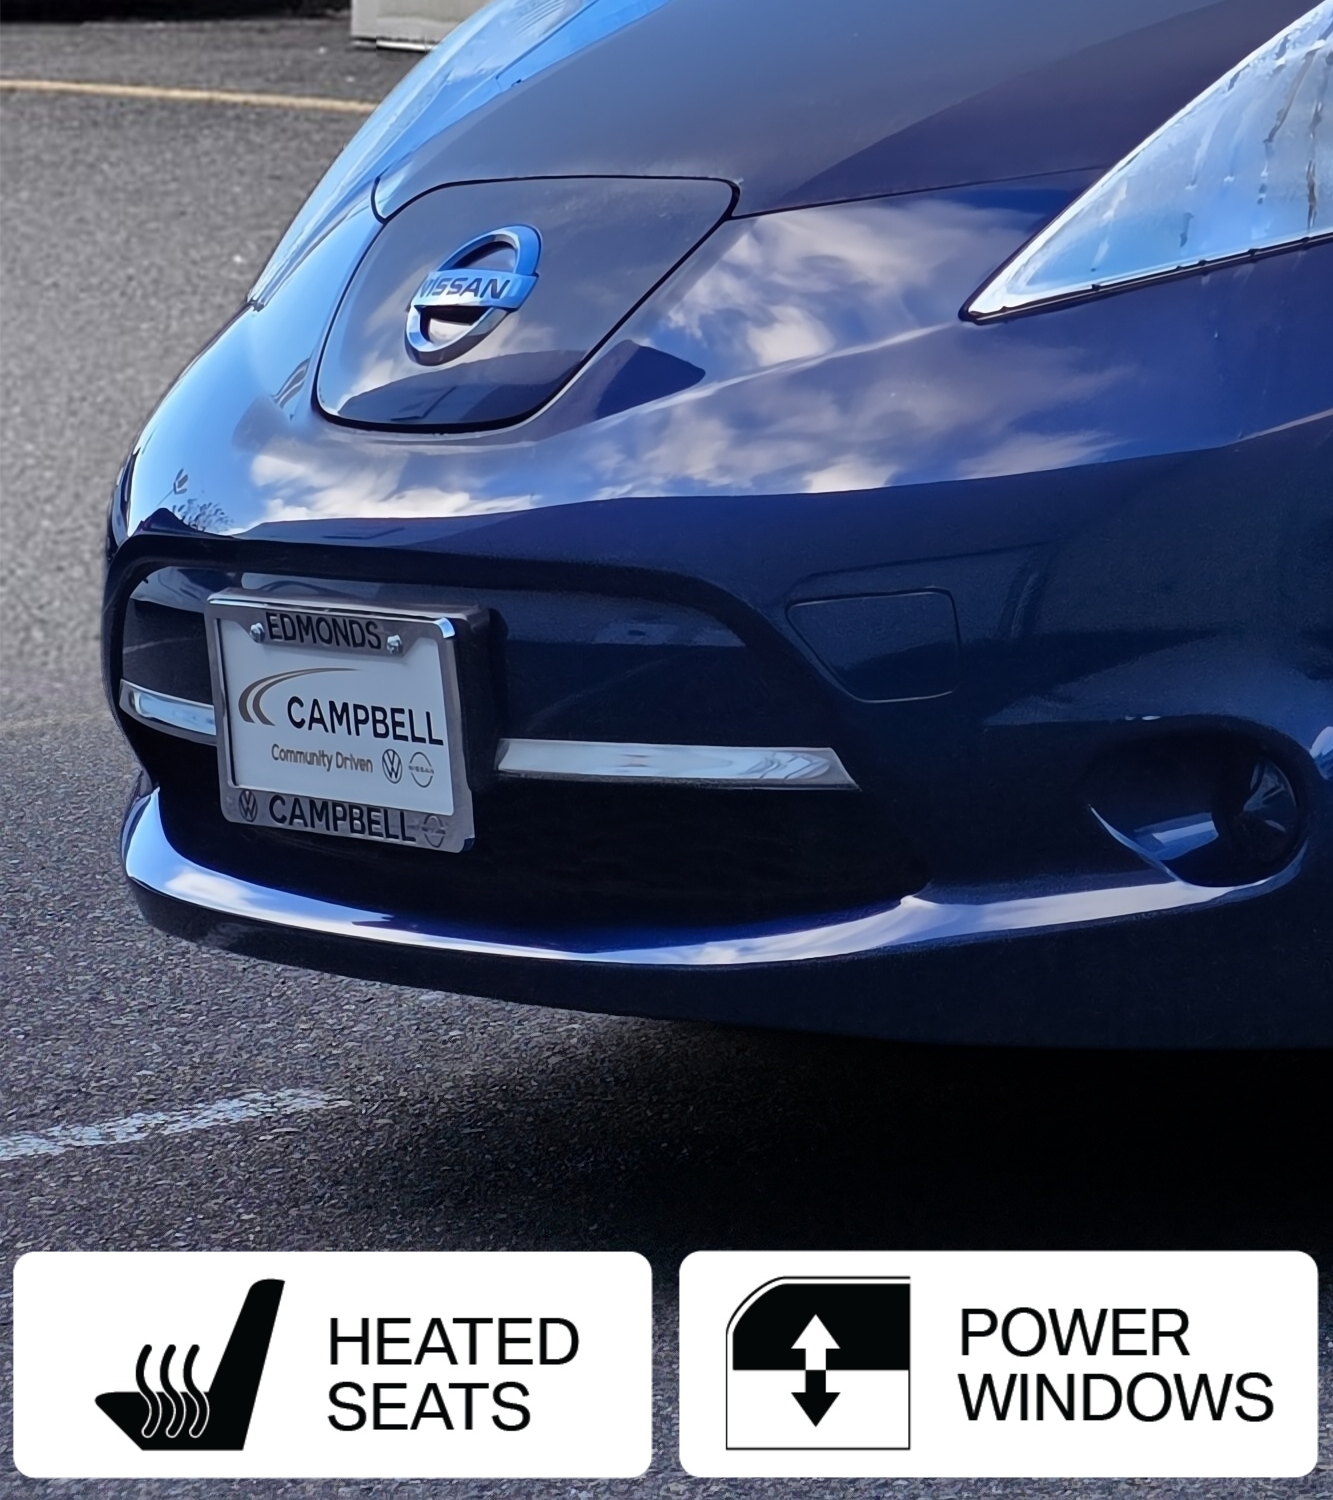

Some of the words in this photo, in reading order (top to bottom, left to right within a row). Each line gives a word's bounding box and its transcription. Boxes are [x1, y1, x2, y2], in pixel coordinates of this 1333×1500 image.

[420, 276, 510, 299] NISSAN
[265, 611, 382, 650] EDMONDS
[287, 696, 444, 746] CAMPBELL
[271, 743, 333, 772] Community
[335, 752, 373, 773] Driven
[269, 795, 416, 844] CAMPBELL
